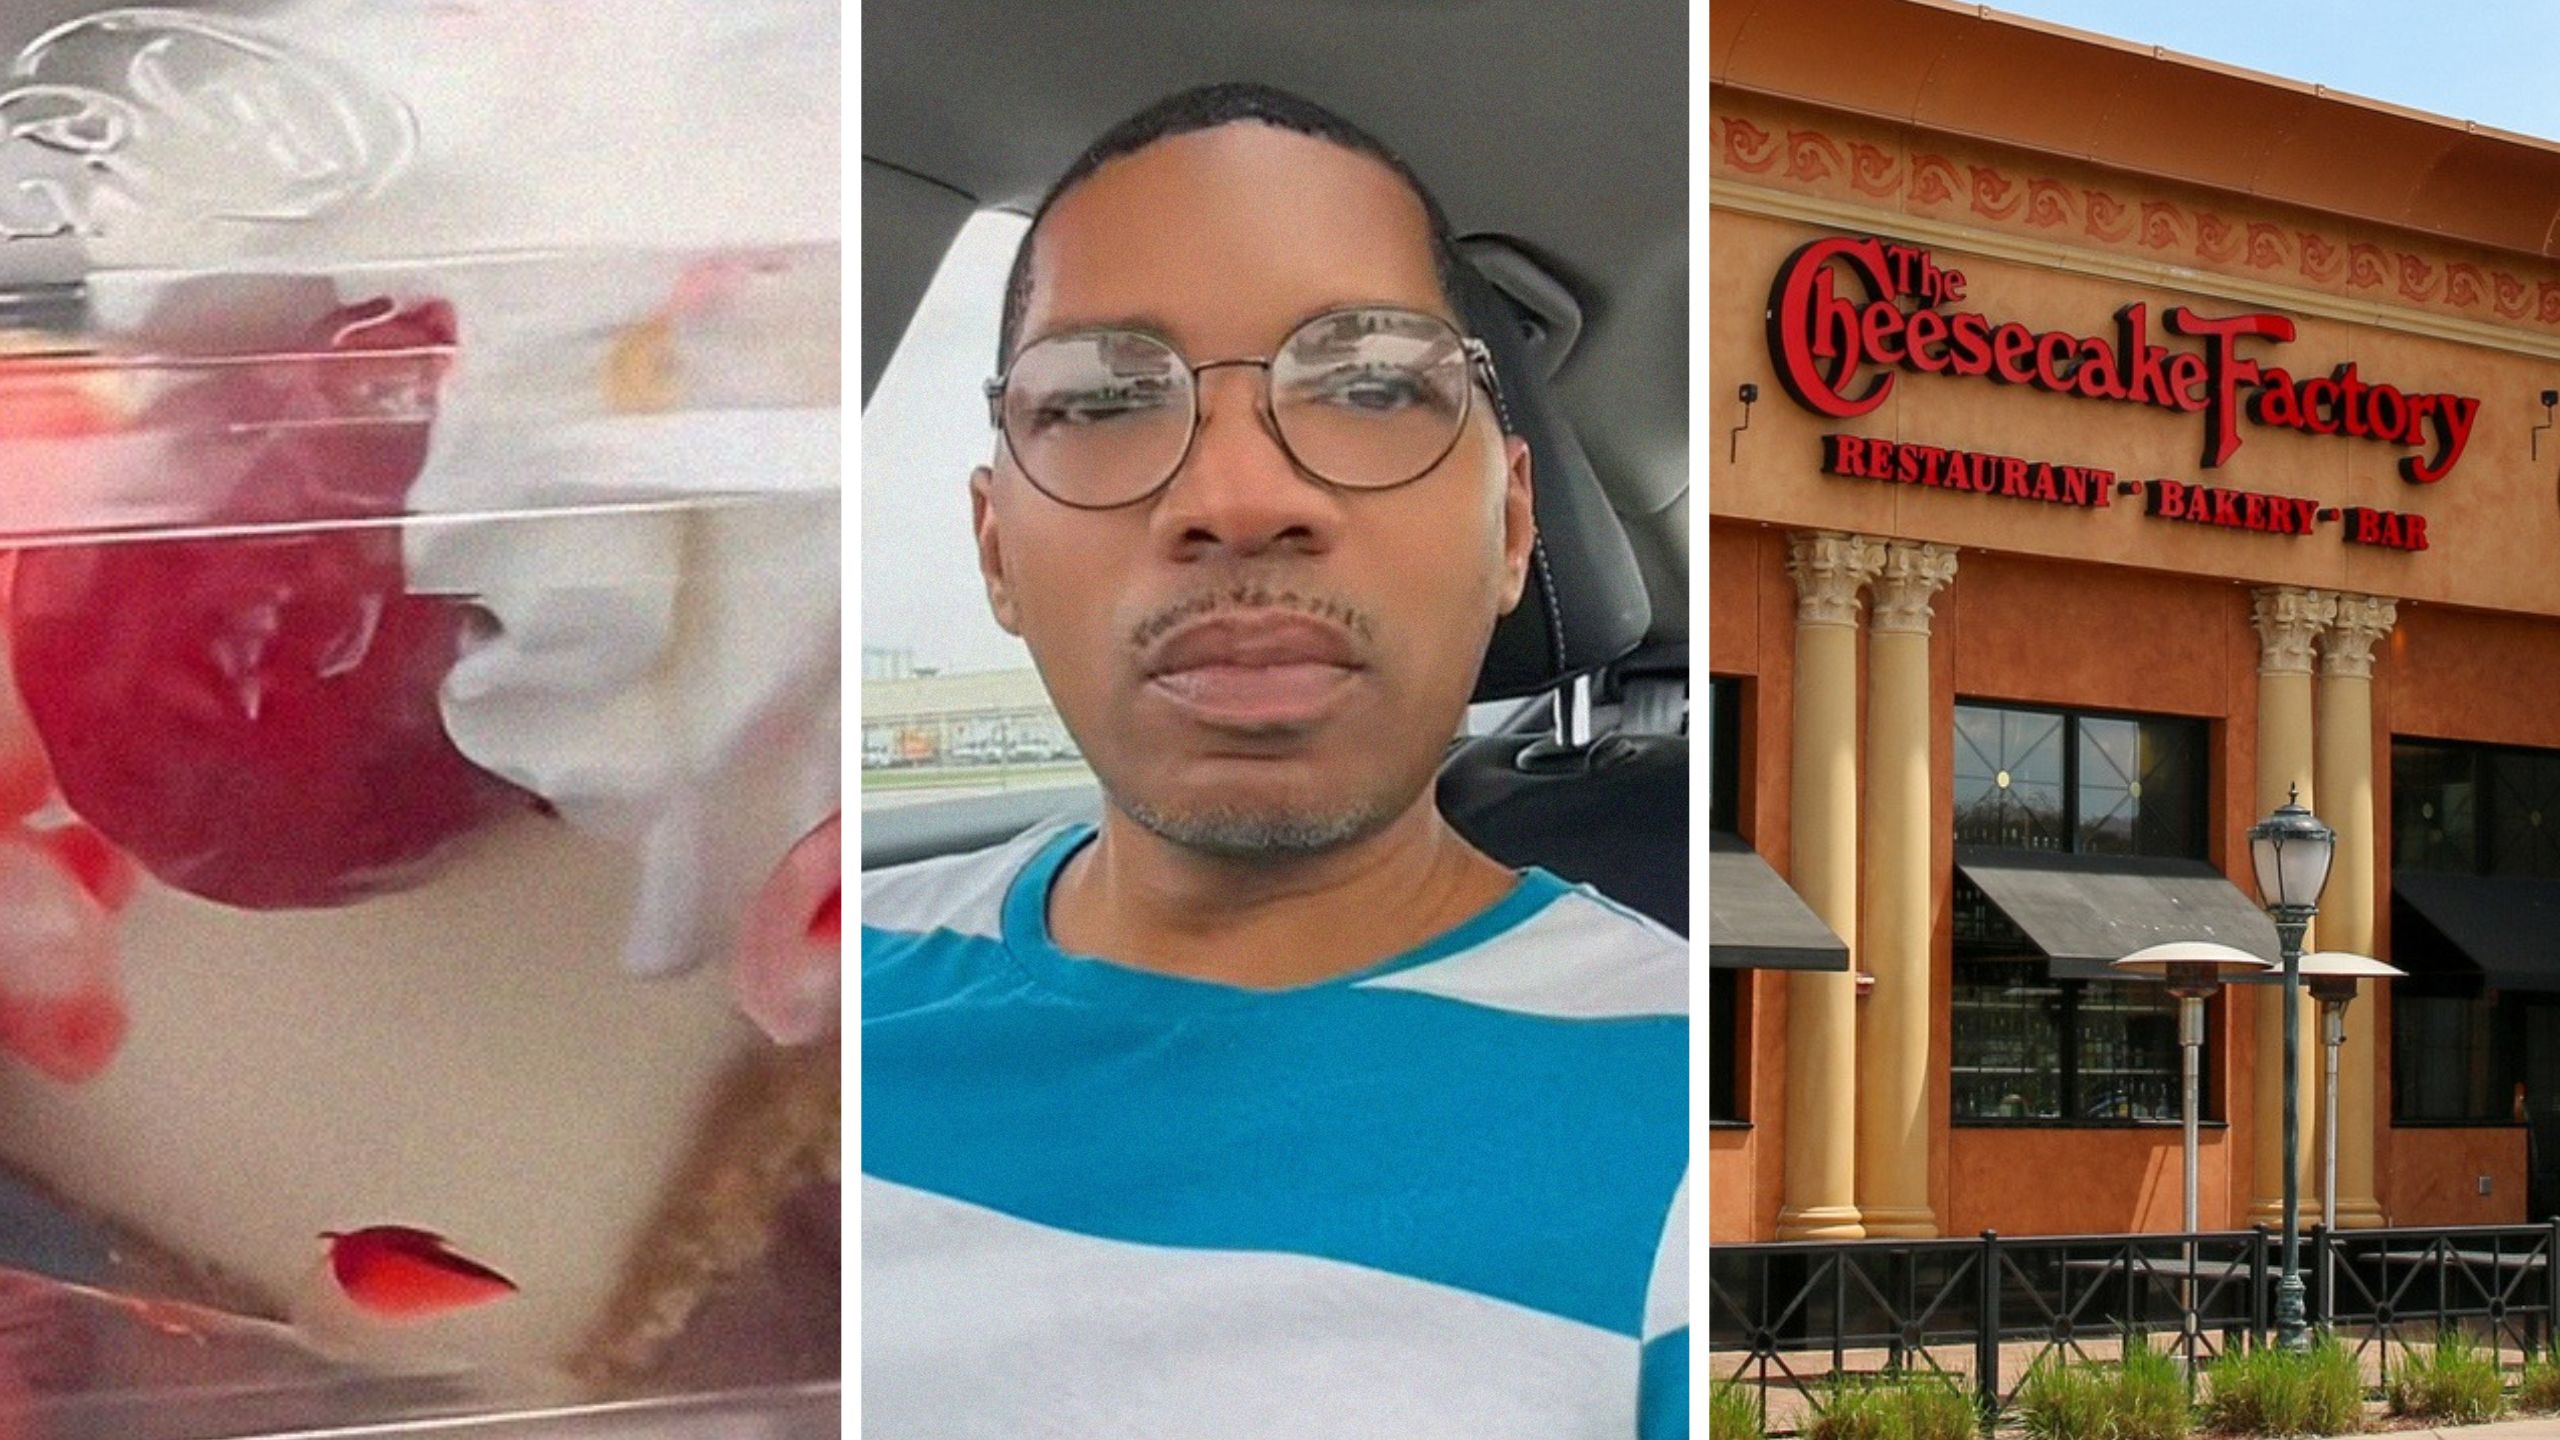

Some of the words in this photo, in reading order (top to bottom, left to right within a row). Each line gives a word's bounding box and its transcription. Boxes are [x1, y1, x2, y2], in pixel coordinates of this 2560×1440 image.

[1888, 245, 1967, 307] The
[1770, 237, 2209, 417] Cheesecake
[2165, 306, 2481, 484] Factory
[1826, 436, 2115, 507] RESTAURANT
[2148, 479, 2319, 536] BAKERY
[2347, 508, 2430, 551] BAR
